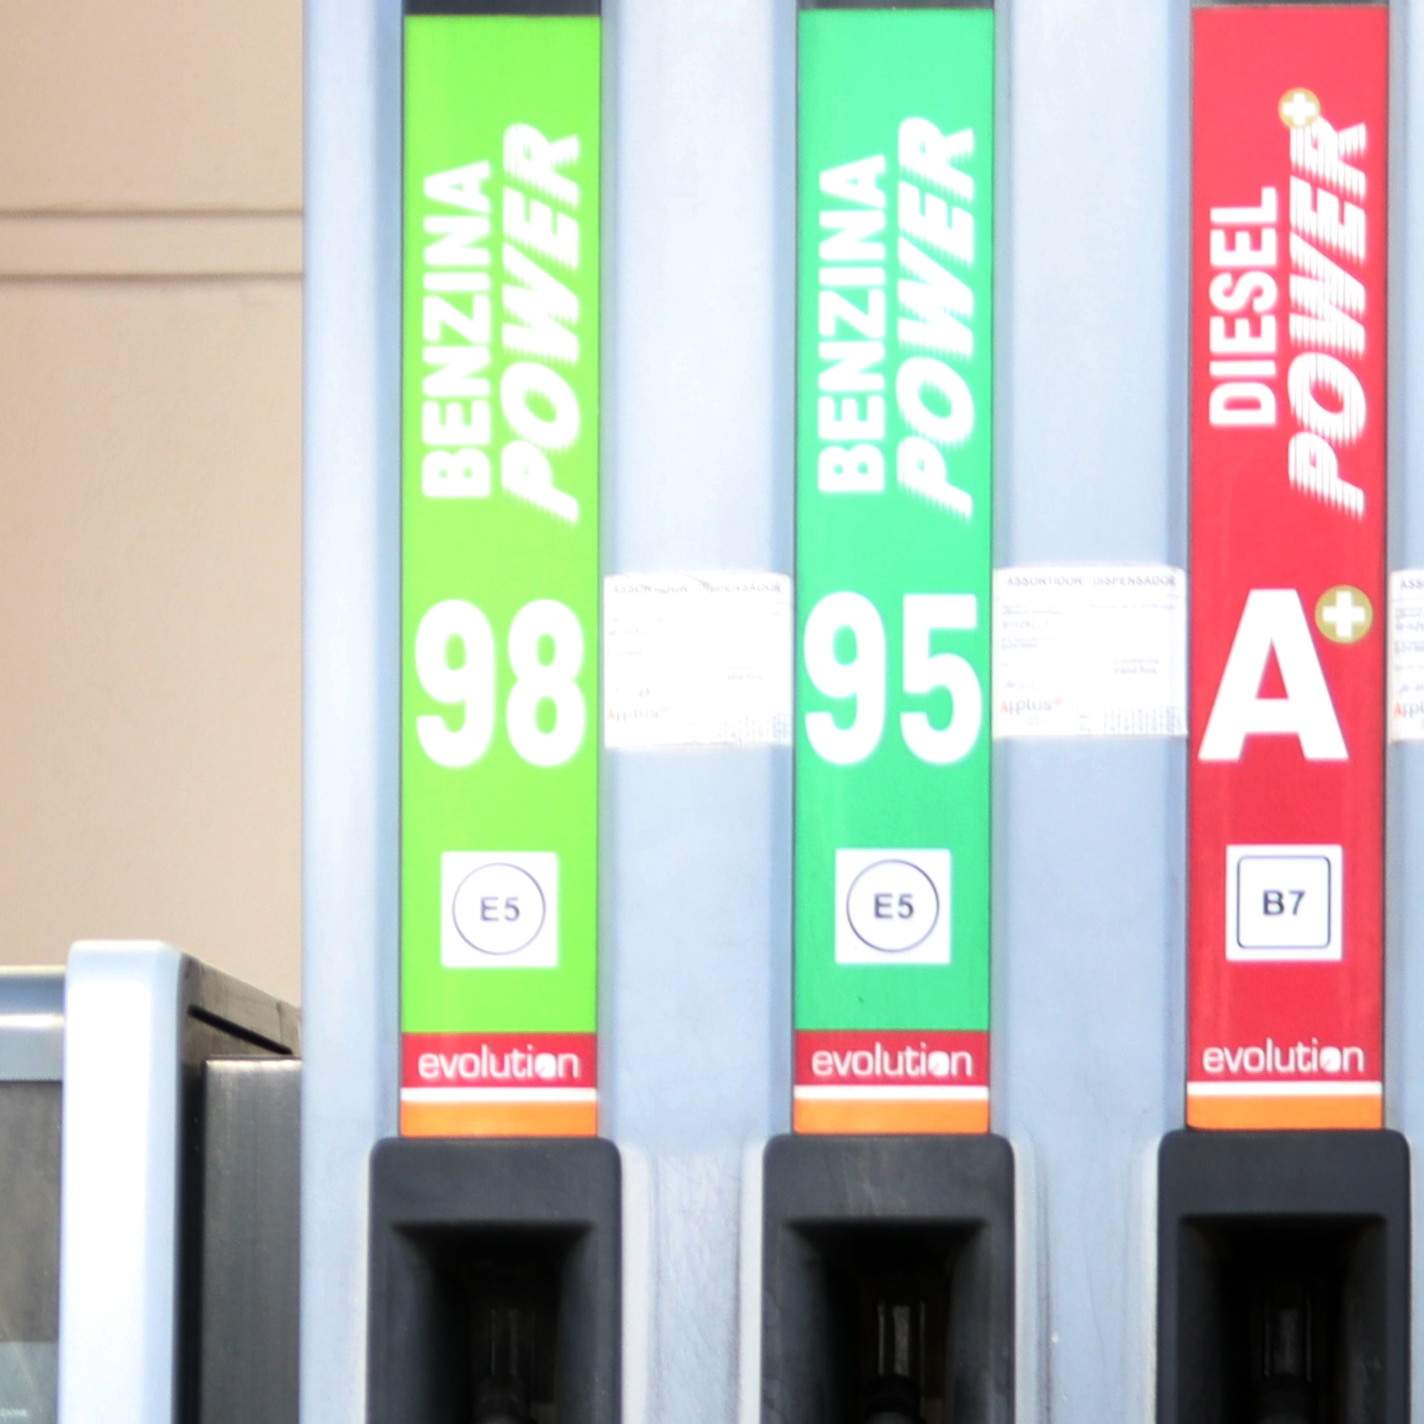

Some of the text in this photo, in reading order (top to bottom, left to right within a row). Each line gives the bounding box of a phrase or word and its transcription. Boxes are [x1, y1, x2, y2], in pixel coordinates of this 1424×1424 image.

[421, 160, 492, 498] BENZINA
[500, 122, 580, 524] POWER
[817, 155, 886, 494] BENZINA
[896, 116, 975, 521] POWER
[1209, 186, 1277, 428] DIESEL
[414, 598, 588, 769] 98
[804, 591, 983, 766] 95
[480, 896, 521, 922] E5
[873, 893, 915, 920] E5
[1262, 889, 1306, 917] B7
[417, 1043, 581, 1081] evolution
[811, 1042, 973, 1079] evolution
[1202, 1036, 1365, 1073] evolution
